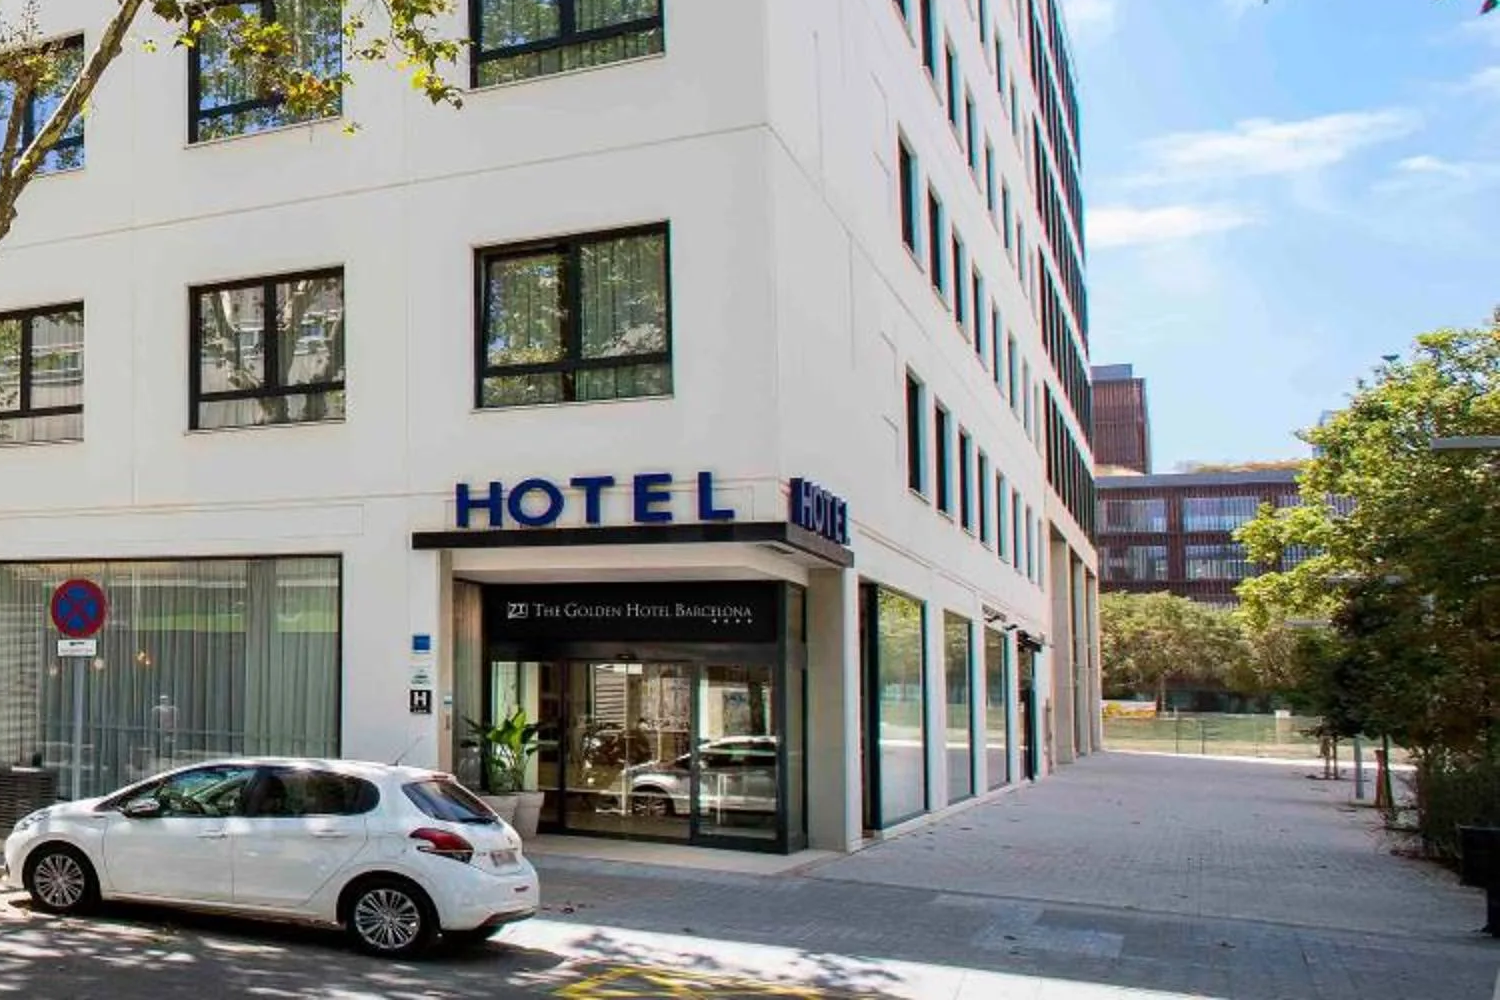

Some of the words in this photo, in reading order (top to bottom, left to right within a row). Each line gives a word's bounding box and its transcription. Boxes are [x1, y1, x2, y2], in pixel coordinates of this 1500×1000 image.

[456, 471, 735, 528] HOTEL
[789, 477, 851, 546] HOTEL
[413, 691, 427, 705] H
